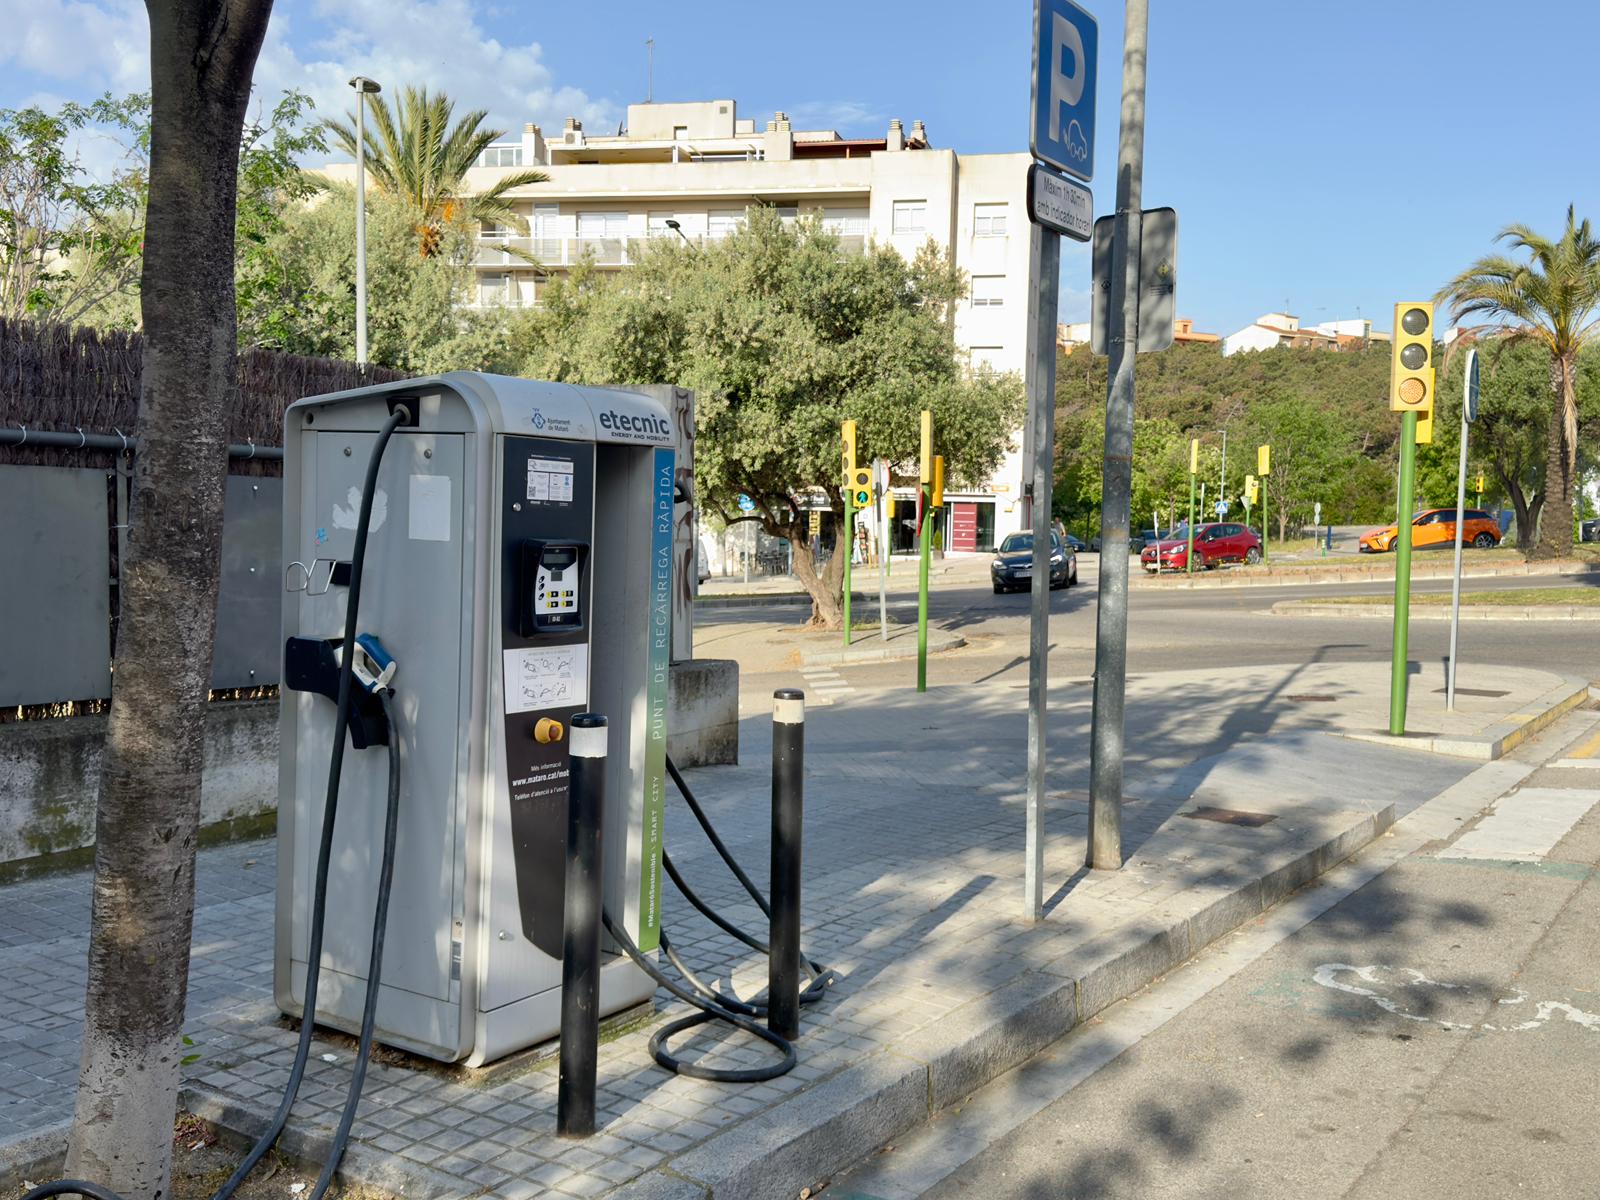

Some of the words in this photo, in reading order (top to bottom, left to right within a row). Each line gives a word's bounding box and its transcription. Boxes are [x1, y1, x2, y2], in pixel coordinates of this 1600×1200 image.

[1049, 10, 1086, 143] P
[1037, 200, 1050, 216] amb
[599, 409, 670, 435] etecnic
[611, 431, 632, 439] ENERGY
[657, 466, 671, 532] RÀPIDA
[654, 662, 665, 683] DE
[652, 696, 664, 740] PUNT
